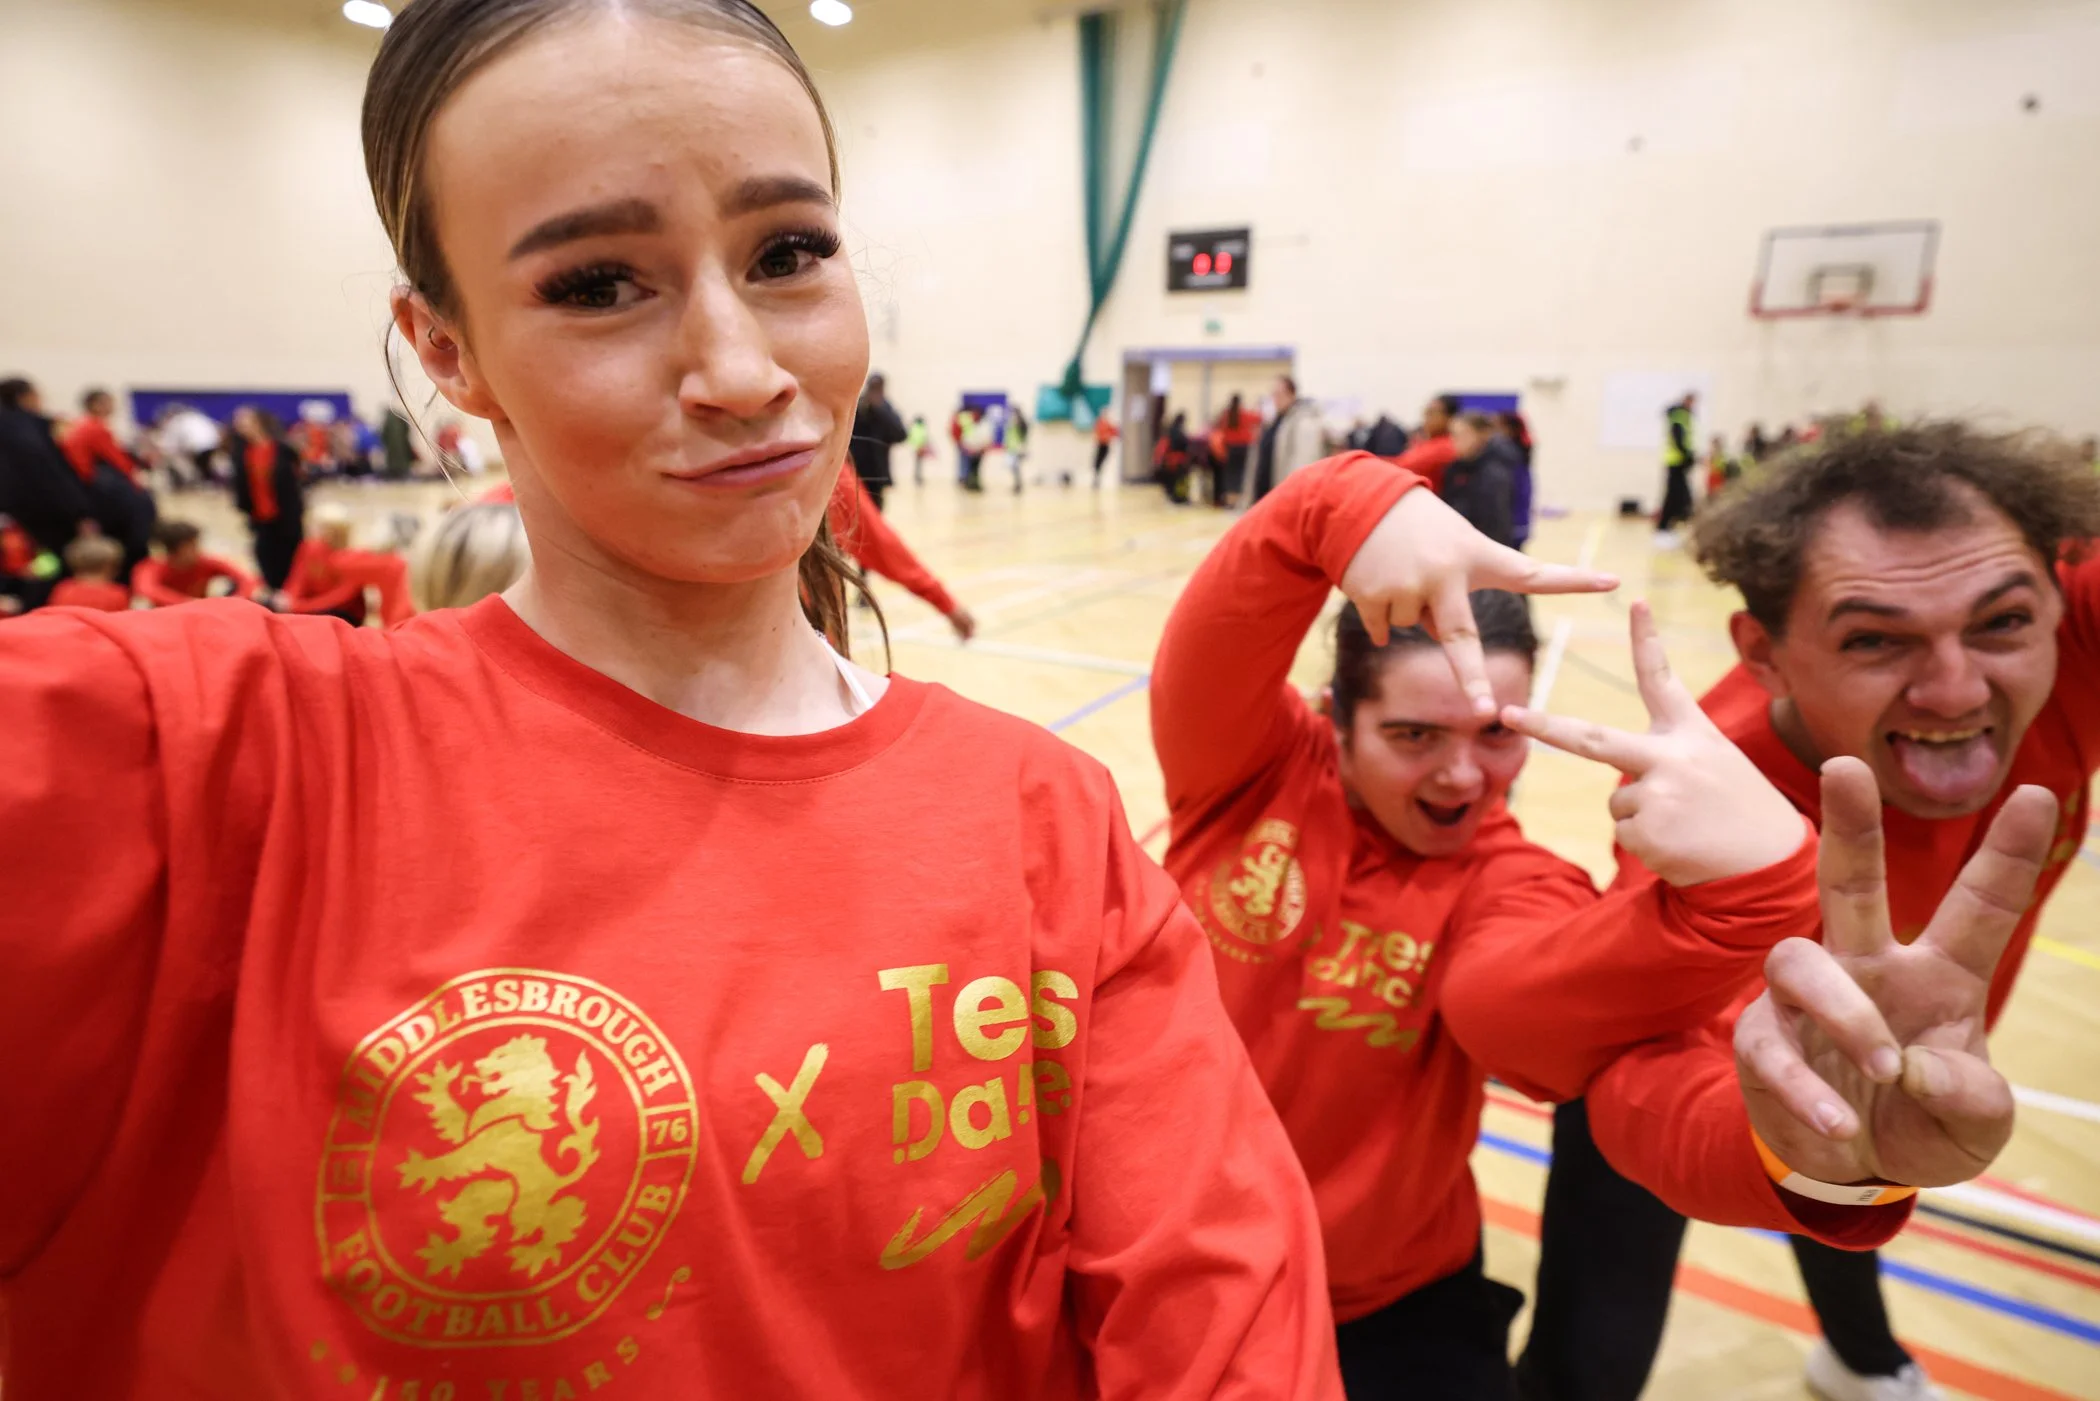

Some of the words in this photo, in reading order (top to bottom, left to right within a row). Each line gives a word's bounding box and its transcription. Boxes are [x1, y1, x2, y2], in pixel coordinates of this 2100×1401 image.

[345, 979, 678, 1130] MIDDLESBROUGH
[651, 1116, 688, 1146] 76
[333, 1227, 568, 1337] FOOTBALL
[576, 1183, 673, 1302] CLUB
[484, 1335, 640, 1401] YEARS
